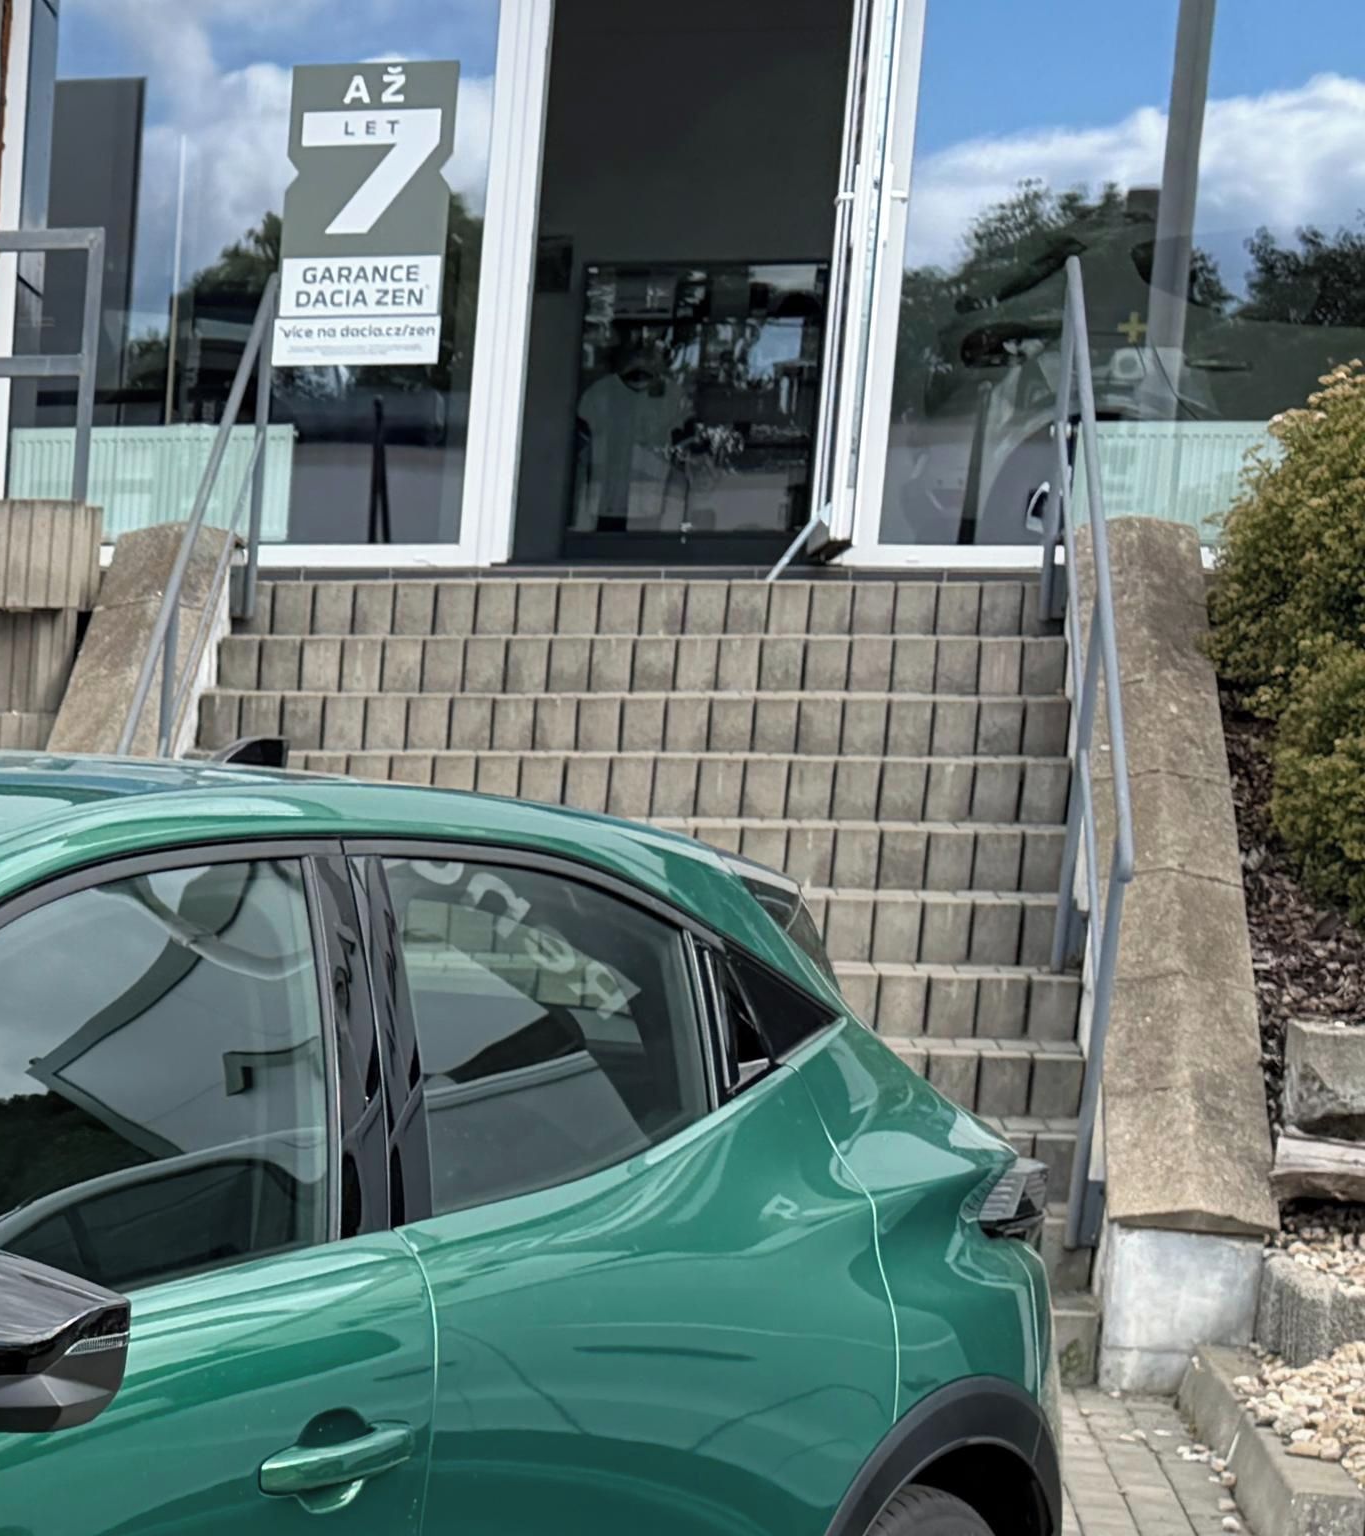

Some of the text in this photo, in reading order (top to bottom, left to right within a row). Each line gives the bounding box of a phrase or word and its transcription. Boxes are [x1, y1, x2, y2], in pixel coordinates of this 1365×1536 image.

[342, 65, 406, 105] AŽ
[343, 119, 401, 137] LET
[301, 108, 442, 235] 7
[302, 264, 420, 284] GARANCE
[294, 289, 368, 308] DACIA
[317, 326, 337, 338] na
